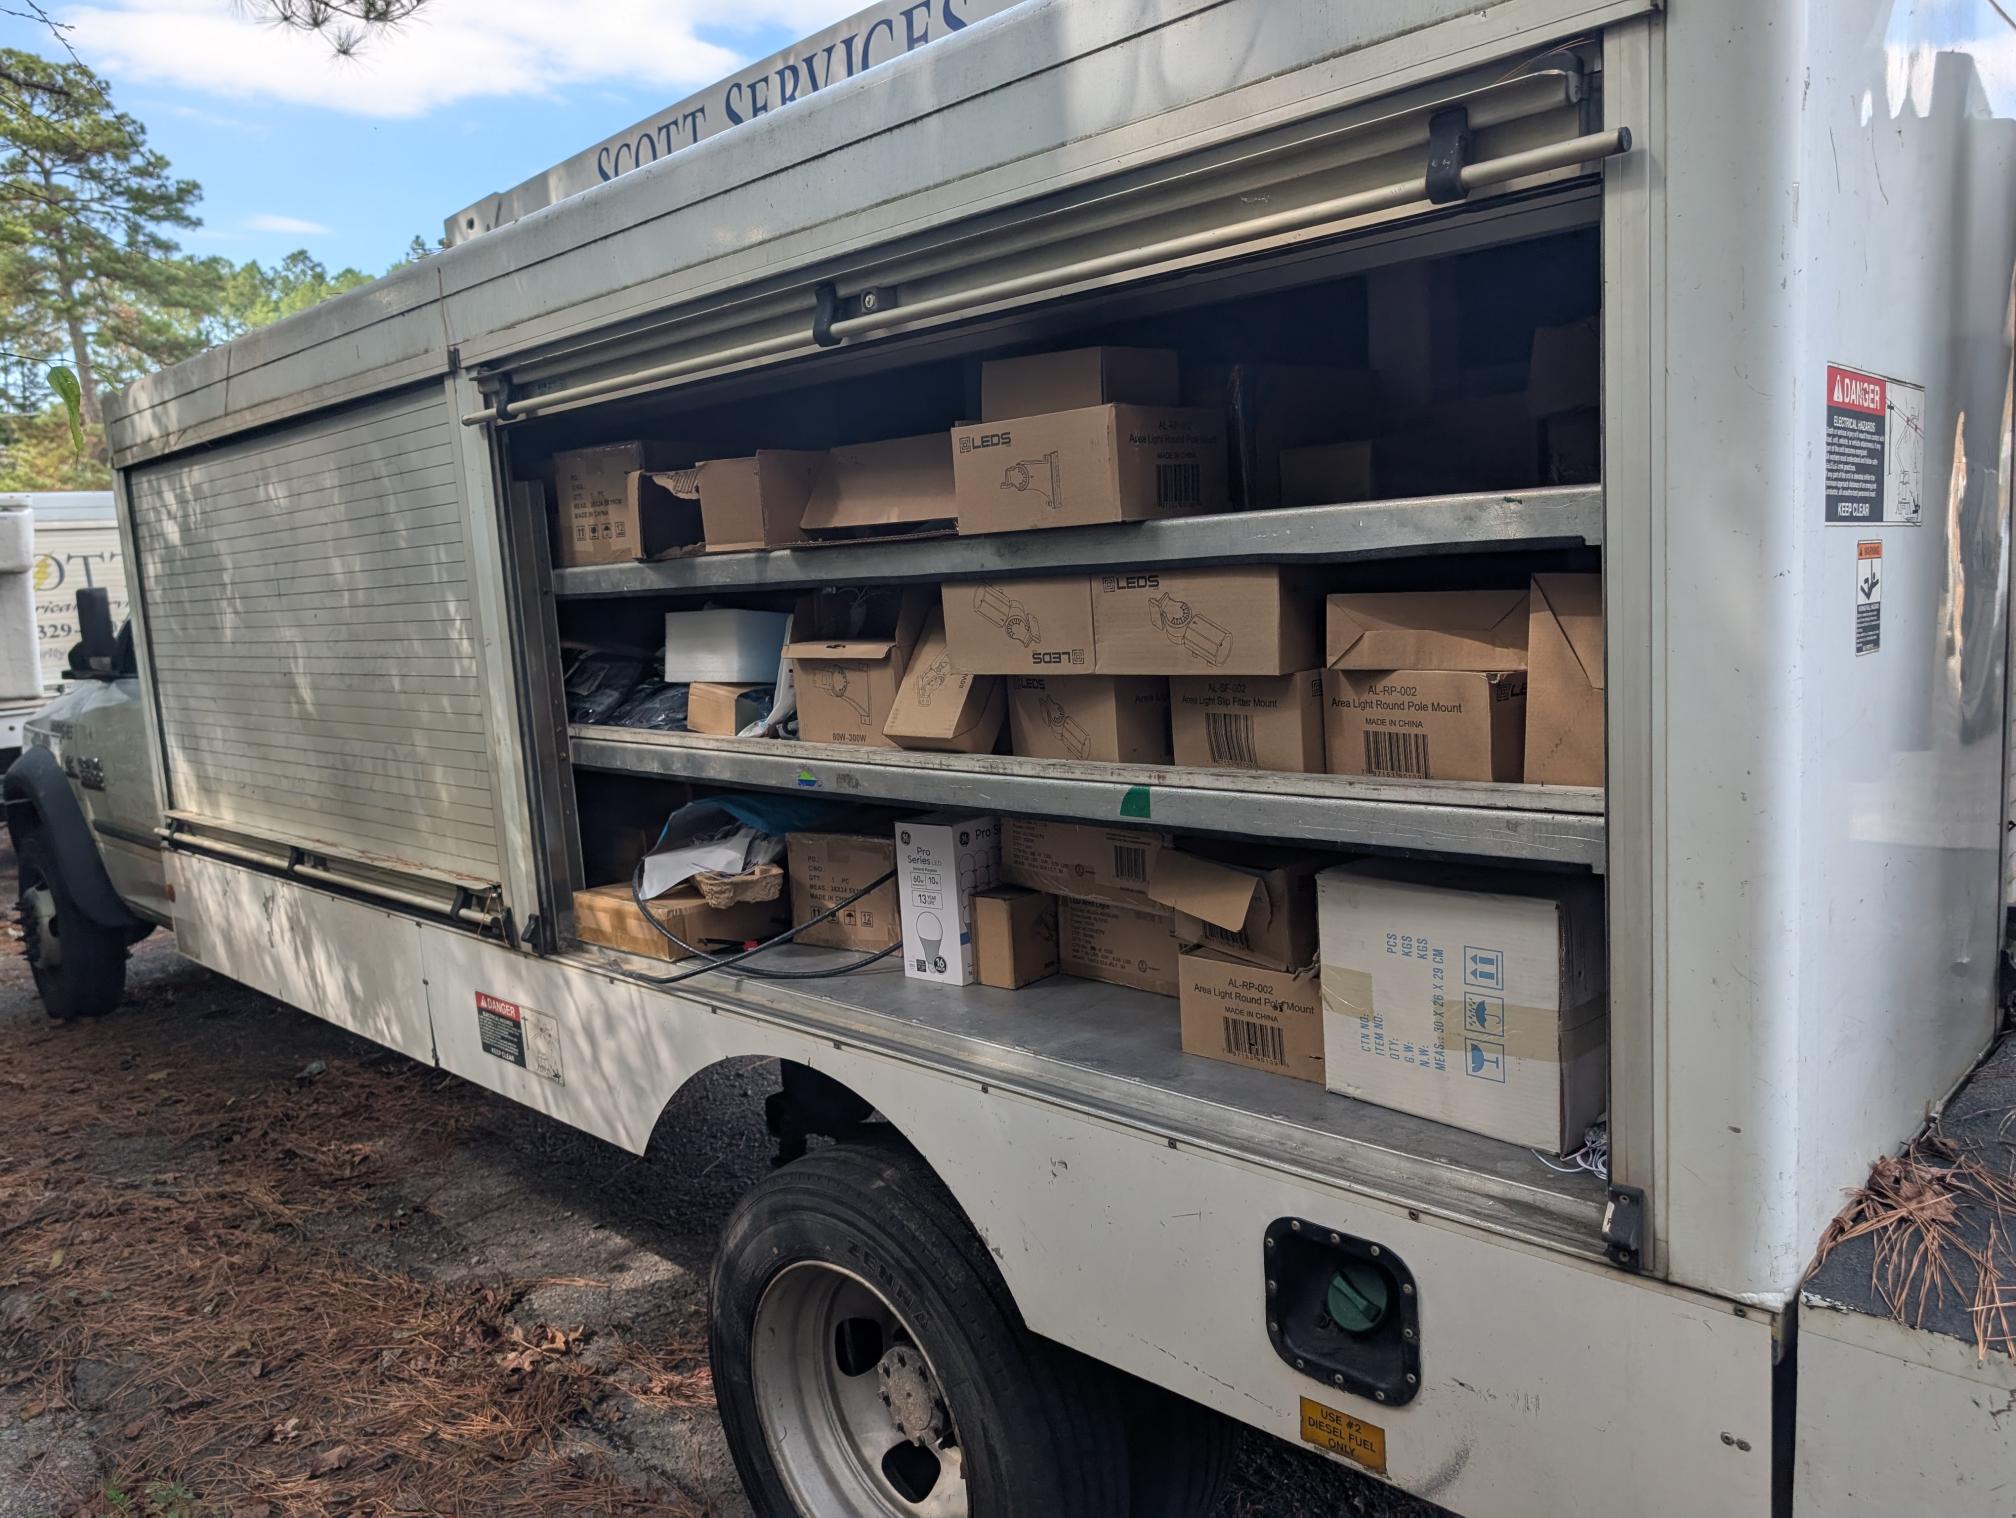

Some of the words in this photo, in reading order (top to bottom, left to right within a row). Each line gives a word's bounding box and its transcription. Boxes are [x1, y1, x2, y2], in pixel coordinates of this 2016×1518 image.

[597, 107, 707, 183] SCOTT
[1844, 377, 1881, 410] DANGER
[971, 431, 1012, 450] LEDS
[1837, 502, 1852, 516] KEEP
[1852, 503, 1870, 517] CLEAR
[1115, 574, 1160, 591] LEDS
[1032, 651, 1072, 664] LEDS
[1367, 685, 1418, 697] AL-RP-002
[1199, 695, 1216, 708] Light
[1253, 698, 1278, 709] Mount
[1331, 697, 1351, 708] Area
[1353, 699, 1374, 711] Light
[1376, 699, 1405, 711] Round
[1407, 701, 1429, 712] Pole
[1431, 701, 1463, 714] Mount
[1365, 717, 1388, 727] MADE
[1389, 718, 1397, 727] IN
[1398, 719, 1424, 729] CHINA
[975, 827, 991, 840] Pro
[916, 846, 931, 857] Pro
[907, 855, 931, 866] Series
[1386, 932, 1397, 954] PCS
[1401, 935, 1413, 957] KGS
[1417, 937, 1428, 960] KGS
[1432, 949, 1444, 965] CM
[1432, 967, 1444, 981] 29
[1228, 978, 1274, 996] AL-RP-002
[1432, 983, 1444, 992] X
[1194, 983, 1212, 995] Area
[1213, 988, 1233, 1000] Light
[1235, 991, 1262, 1006] Round
[1286, 1002, 1315, 1015] Mount
[1432, 994, 1444, 1007] 26
[486, 998, 516, 1018] DANGER
[1224, 1006, 1245, 1017] MADE
[1246, 1009, 1254, 1018] IN
[1255, 1011, 1279, 1023] CHINA
[1433, 1010, 1444, 1019] X
[1360, 1013, 1370, 1030] NO:
[1374, 1012, 1384, 1031] NO:
[1433, 1020, 1444, 1033] 30
[1360, 1031, 1371, 1053] CTN
[1374, 1034, 1385, 1056] ITEM
[1320, 1408, 1342, 1426] USE
[1346, 1420, 1362, 1434] #2
[1308, 1416, 1346, 1440] DIESEL
[1348, 1433, 1377, 1453] FUEL
[1327, 1438, 1356, 1457] ONLY
